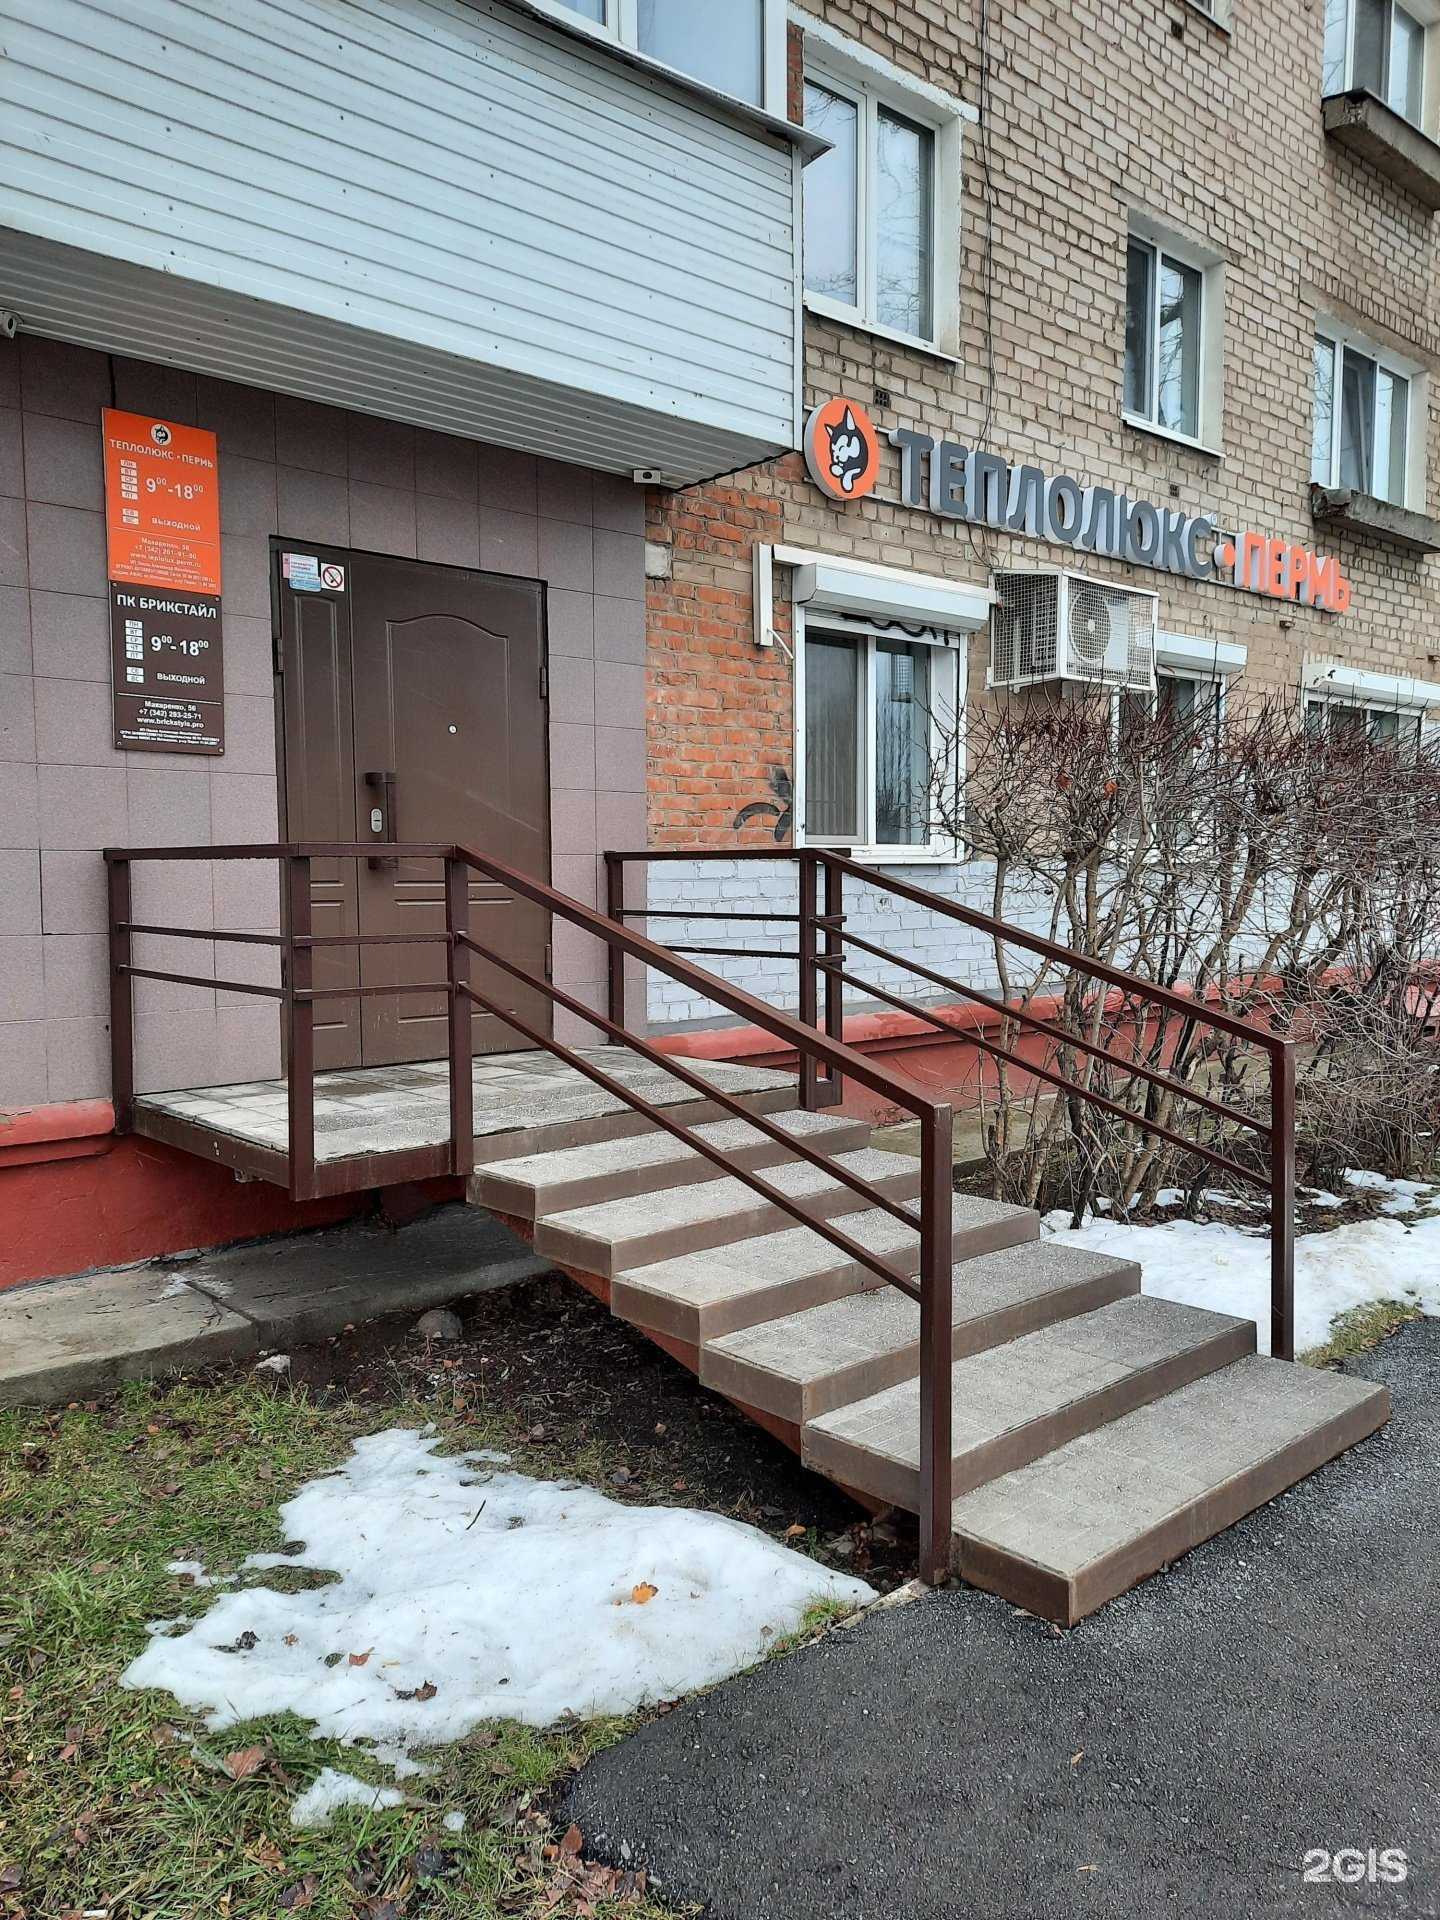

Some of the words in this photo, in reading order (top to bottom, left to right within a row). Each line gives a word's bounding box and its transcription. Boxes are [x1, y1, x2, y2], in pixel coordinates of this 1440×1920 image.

[109, 439, 174, 460] ТЕПЛОЛЮКС
[182, 455, 214, 468] ПЕРМЬ
[889, 428, 1216, 578] ТЕПЛОЛЮКС
[1234, 530, 1352, 614] ПЕРМЬ
[116, 595, 137, 608] ПК
[139, 598, 217, 619] БРИКСТАЙЛ
[157, 672, 206, 685] ВЫХОДНОЙ
[150, 709, 168, 718] (342)
